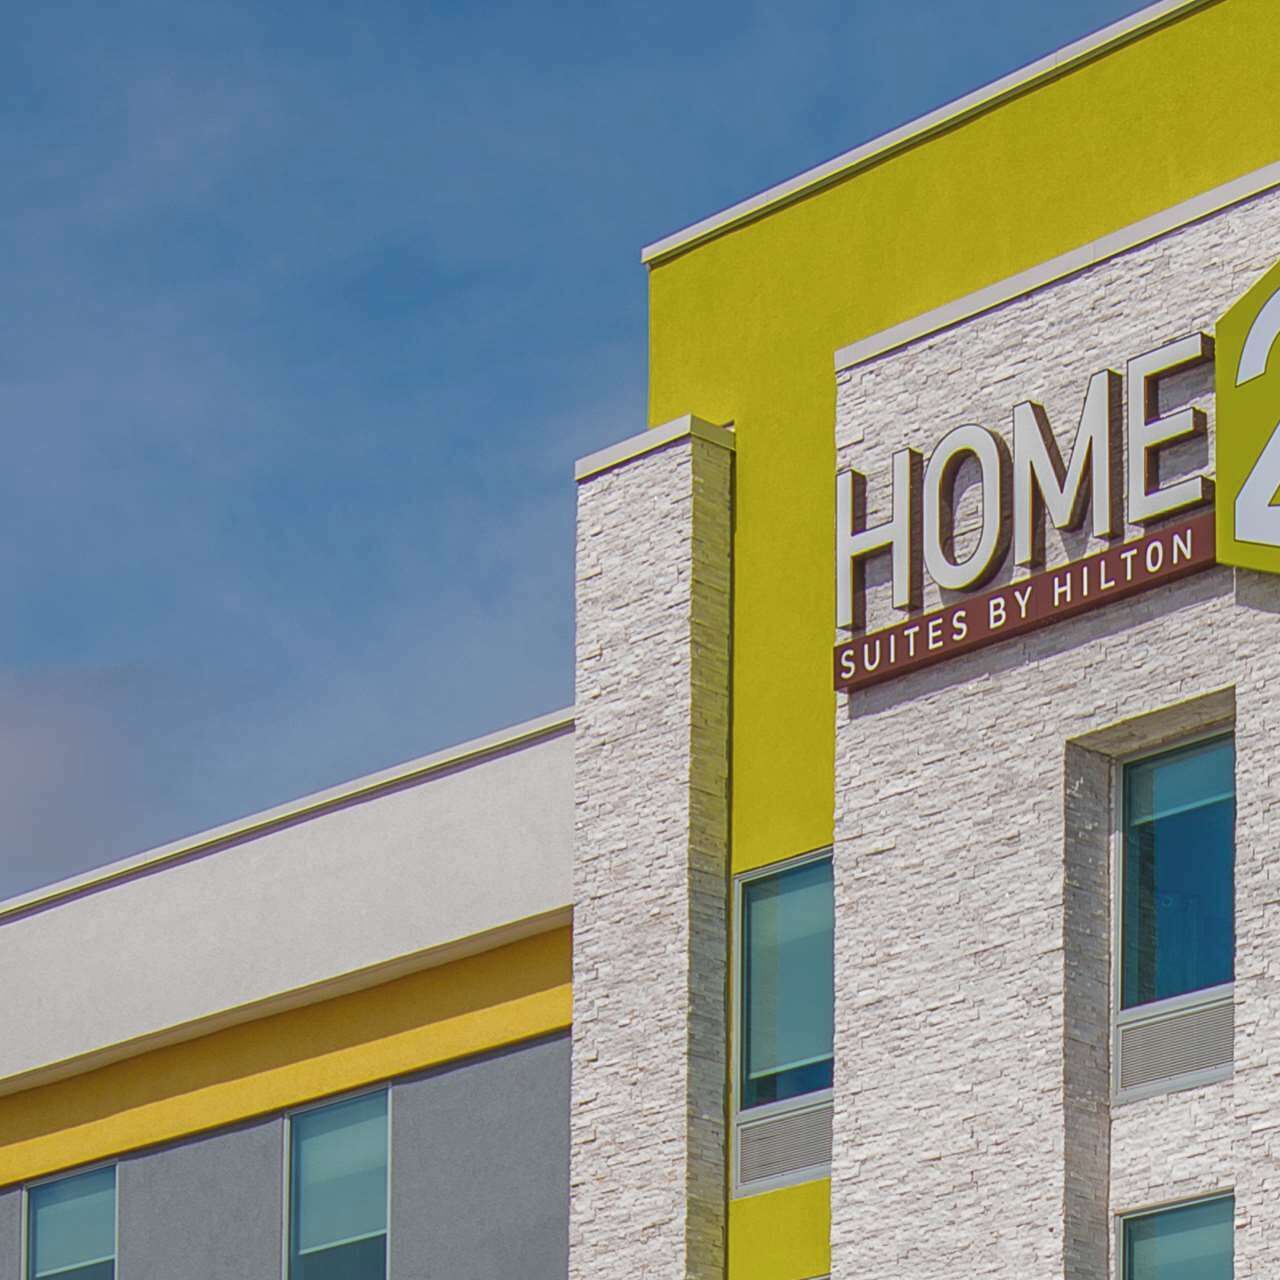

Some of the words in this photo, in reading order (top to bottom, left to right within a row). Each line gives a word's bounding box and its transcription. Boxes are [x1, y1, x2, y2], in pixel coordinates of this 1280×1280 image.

[836, 331, 1205, 630] HOME
[840, 609, 968, 680] SUITES
[988, 586, 1033, 630] BY
[1052, 528, 1193, 608] HILTON
